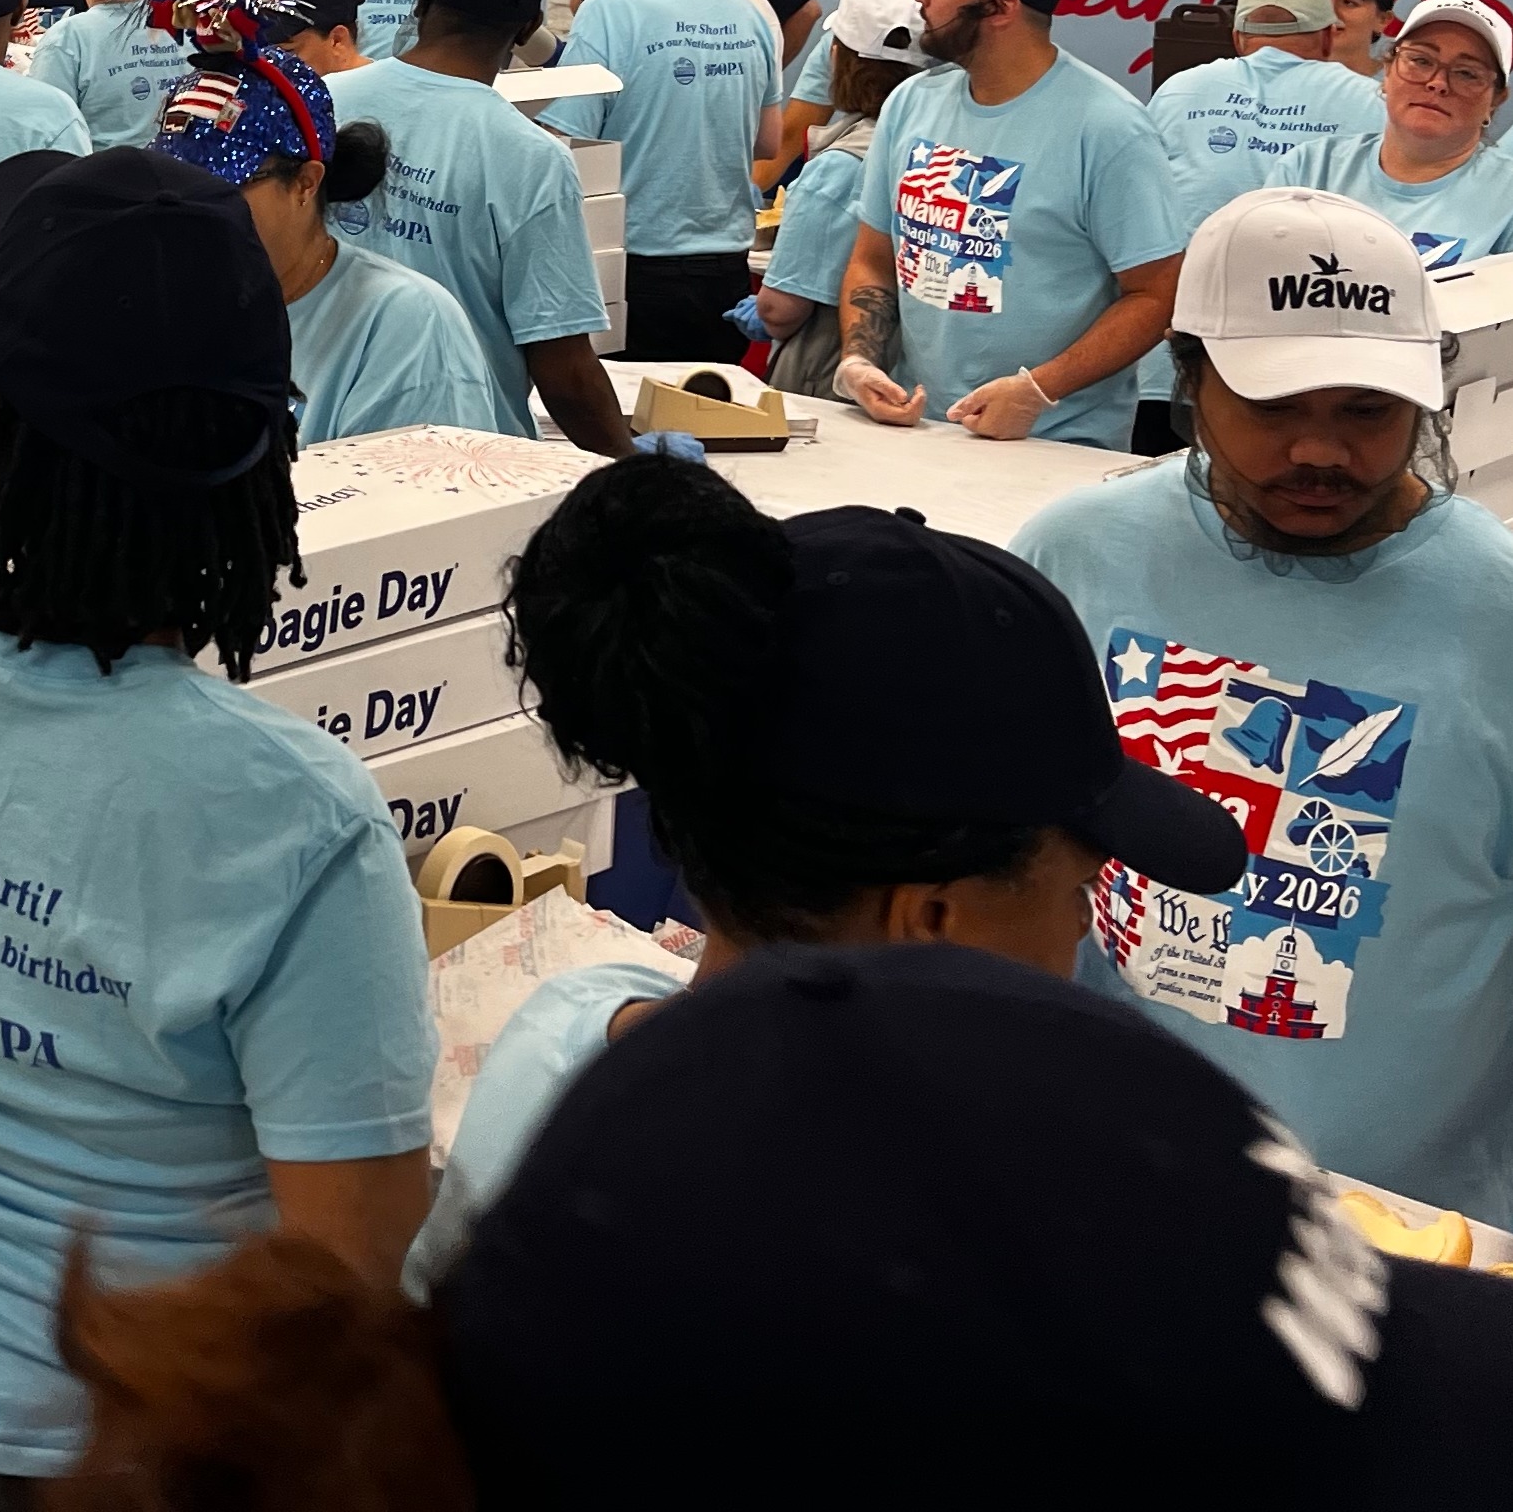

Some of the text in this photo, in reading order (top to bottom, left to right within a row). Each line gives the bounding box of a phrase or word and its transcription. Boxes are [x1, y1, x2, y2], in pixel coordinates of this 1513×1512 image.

[666, 38, 683, 48] our
[676, 21, 697, 34] Hey
[1226, 93, 1255, 108] Hey
[1187, 110, 1206, 120] It's
[1208, 108, 1230, 117] our
[1280, 122, 1340, 134] birthday
[1247, 136, 1296, 155] 250P
[409, 190, 462, 217] birthday
[900, 192, 962, 230] Wawa
[939, 232, 962, 255] Day
[965, 239, 1002, 258] 2026
[1269, 274, 1391, 315] Wawa
[296, 484, 367, 516] hday
[254, 563, 454, 656] oagie Day
[363, 684, 442, 740] Day
[387, 792, 462, 844] Day
[1273, 872, 1362, 919] 2026
[1153, 888, 1207, 943] We
[0, 935, 133, 1007] birthday
